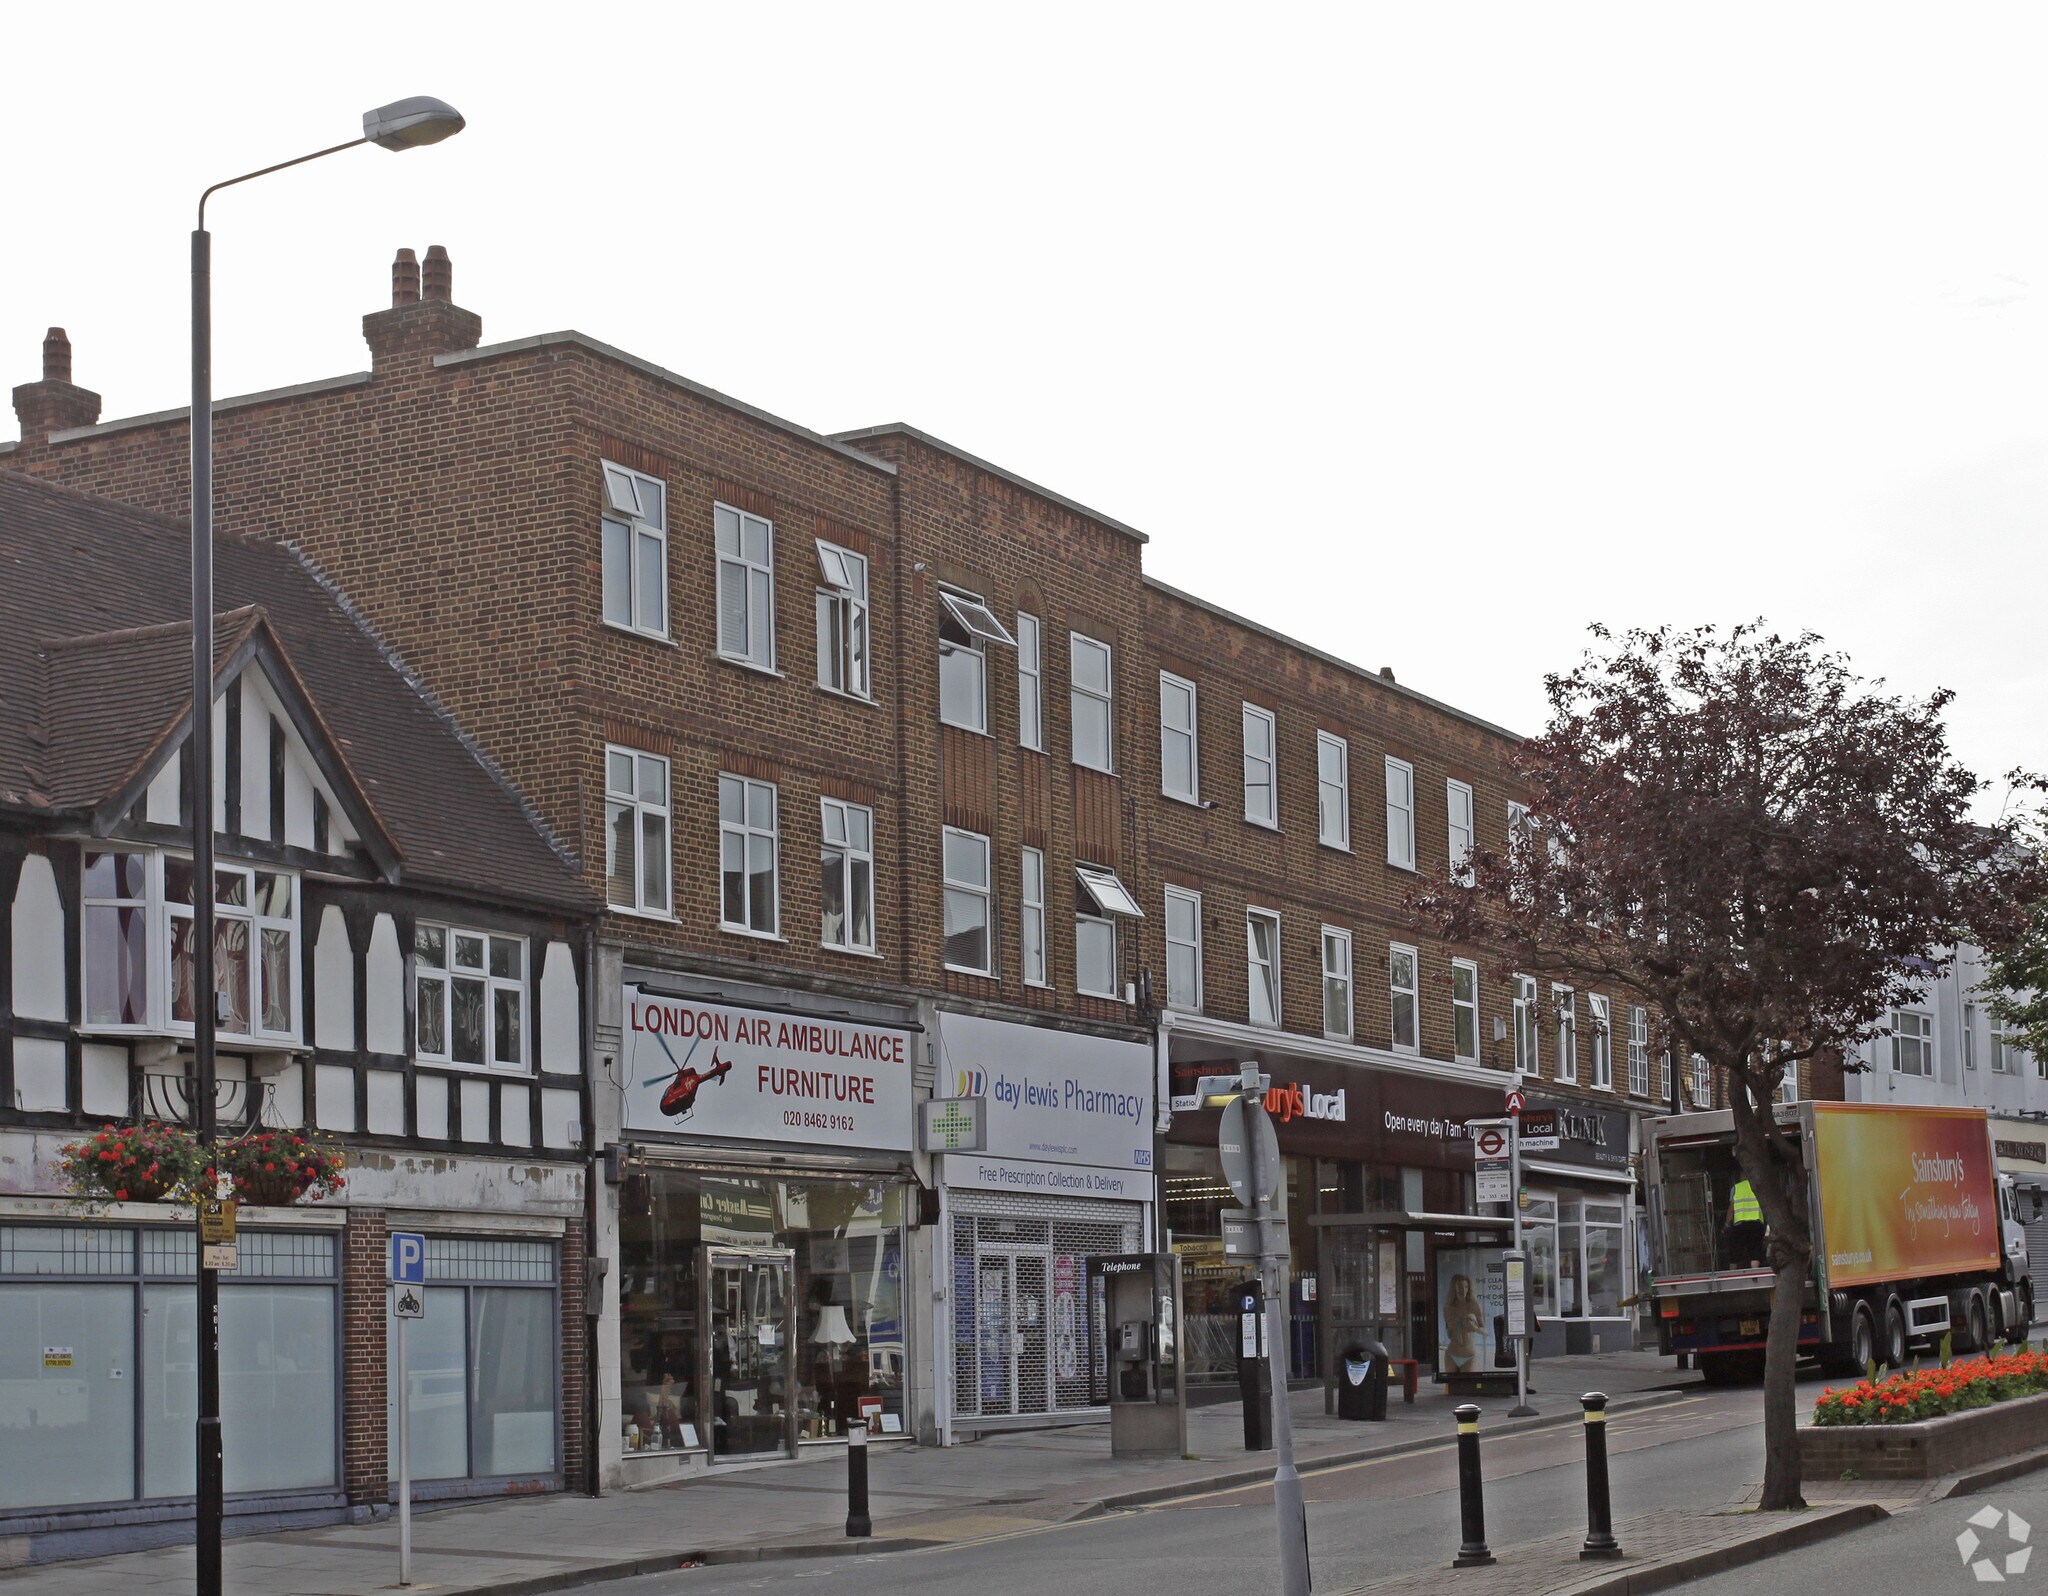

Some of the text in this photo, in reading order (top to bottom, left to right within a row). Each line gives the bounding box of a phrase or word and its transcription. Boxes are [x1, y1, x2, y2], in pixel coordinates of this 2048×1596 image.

[631, 1002, 904, 1063] LONDON AIR AMBULANCE
[1174, 1063, 1233, 1078] Sainsbury's
[758, 1065, 875, 1104] FURNITURE
[995, 1074, 1144, 1126] day lewis Pharmacy
[1263, 1082, 1346, 1123] ury's Local
[1508, 1094, 1521, 1109] A
[783, 1110, 854, 1131] 020 8462 9162
[1384, 1111, 1406, 1132] Open
[1407, 1118, 1429, 1137] every
[1430, 1117, 1444, 1139] day
[1445, 1119, 1462, 1137] 7am
[1527, 1123, 1553, 1134] Local
[1525, 1139, 1554, 1147] machine
[1134, 1150, 1150, 1165] NHS
[979, 1165, 1124, 1194] Free Prescription Collection & Delivery
[1911, 1151, 1965, 1188] Sainsbury's
[1900, 1186, 1916, 1241] Try
[1915, 1195, 1949, 1238] something
[1961, 1192, 1980, 1236] today
[400, 1239, 420, 1278] P
[1179, 1244, 1208, 1252] Tobacco
[1831, 1249, 1873, 1268] sainsburys.co.uk
[1101, 1262, 1141, 1273] Telephone
[1245, 1295, 1254, 1310] P
